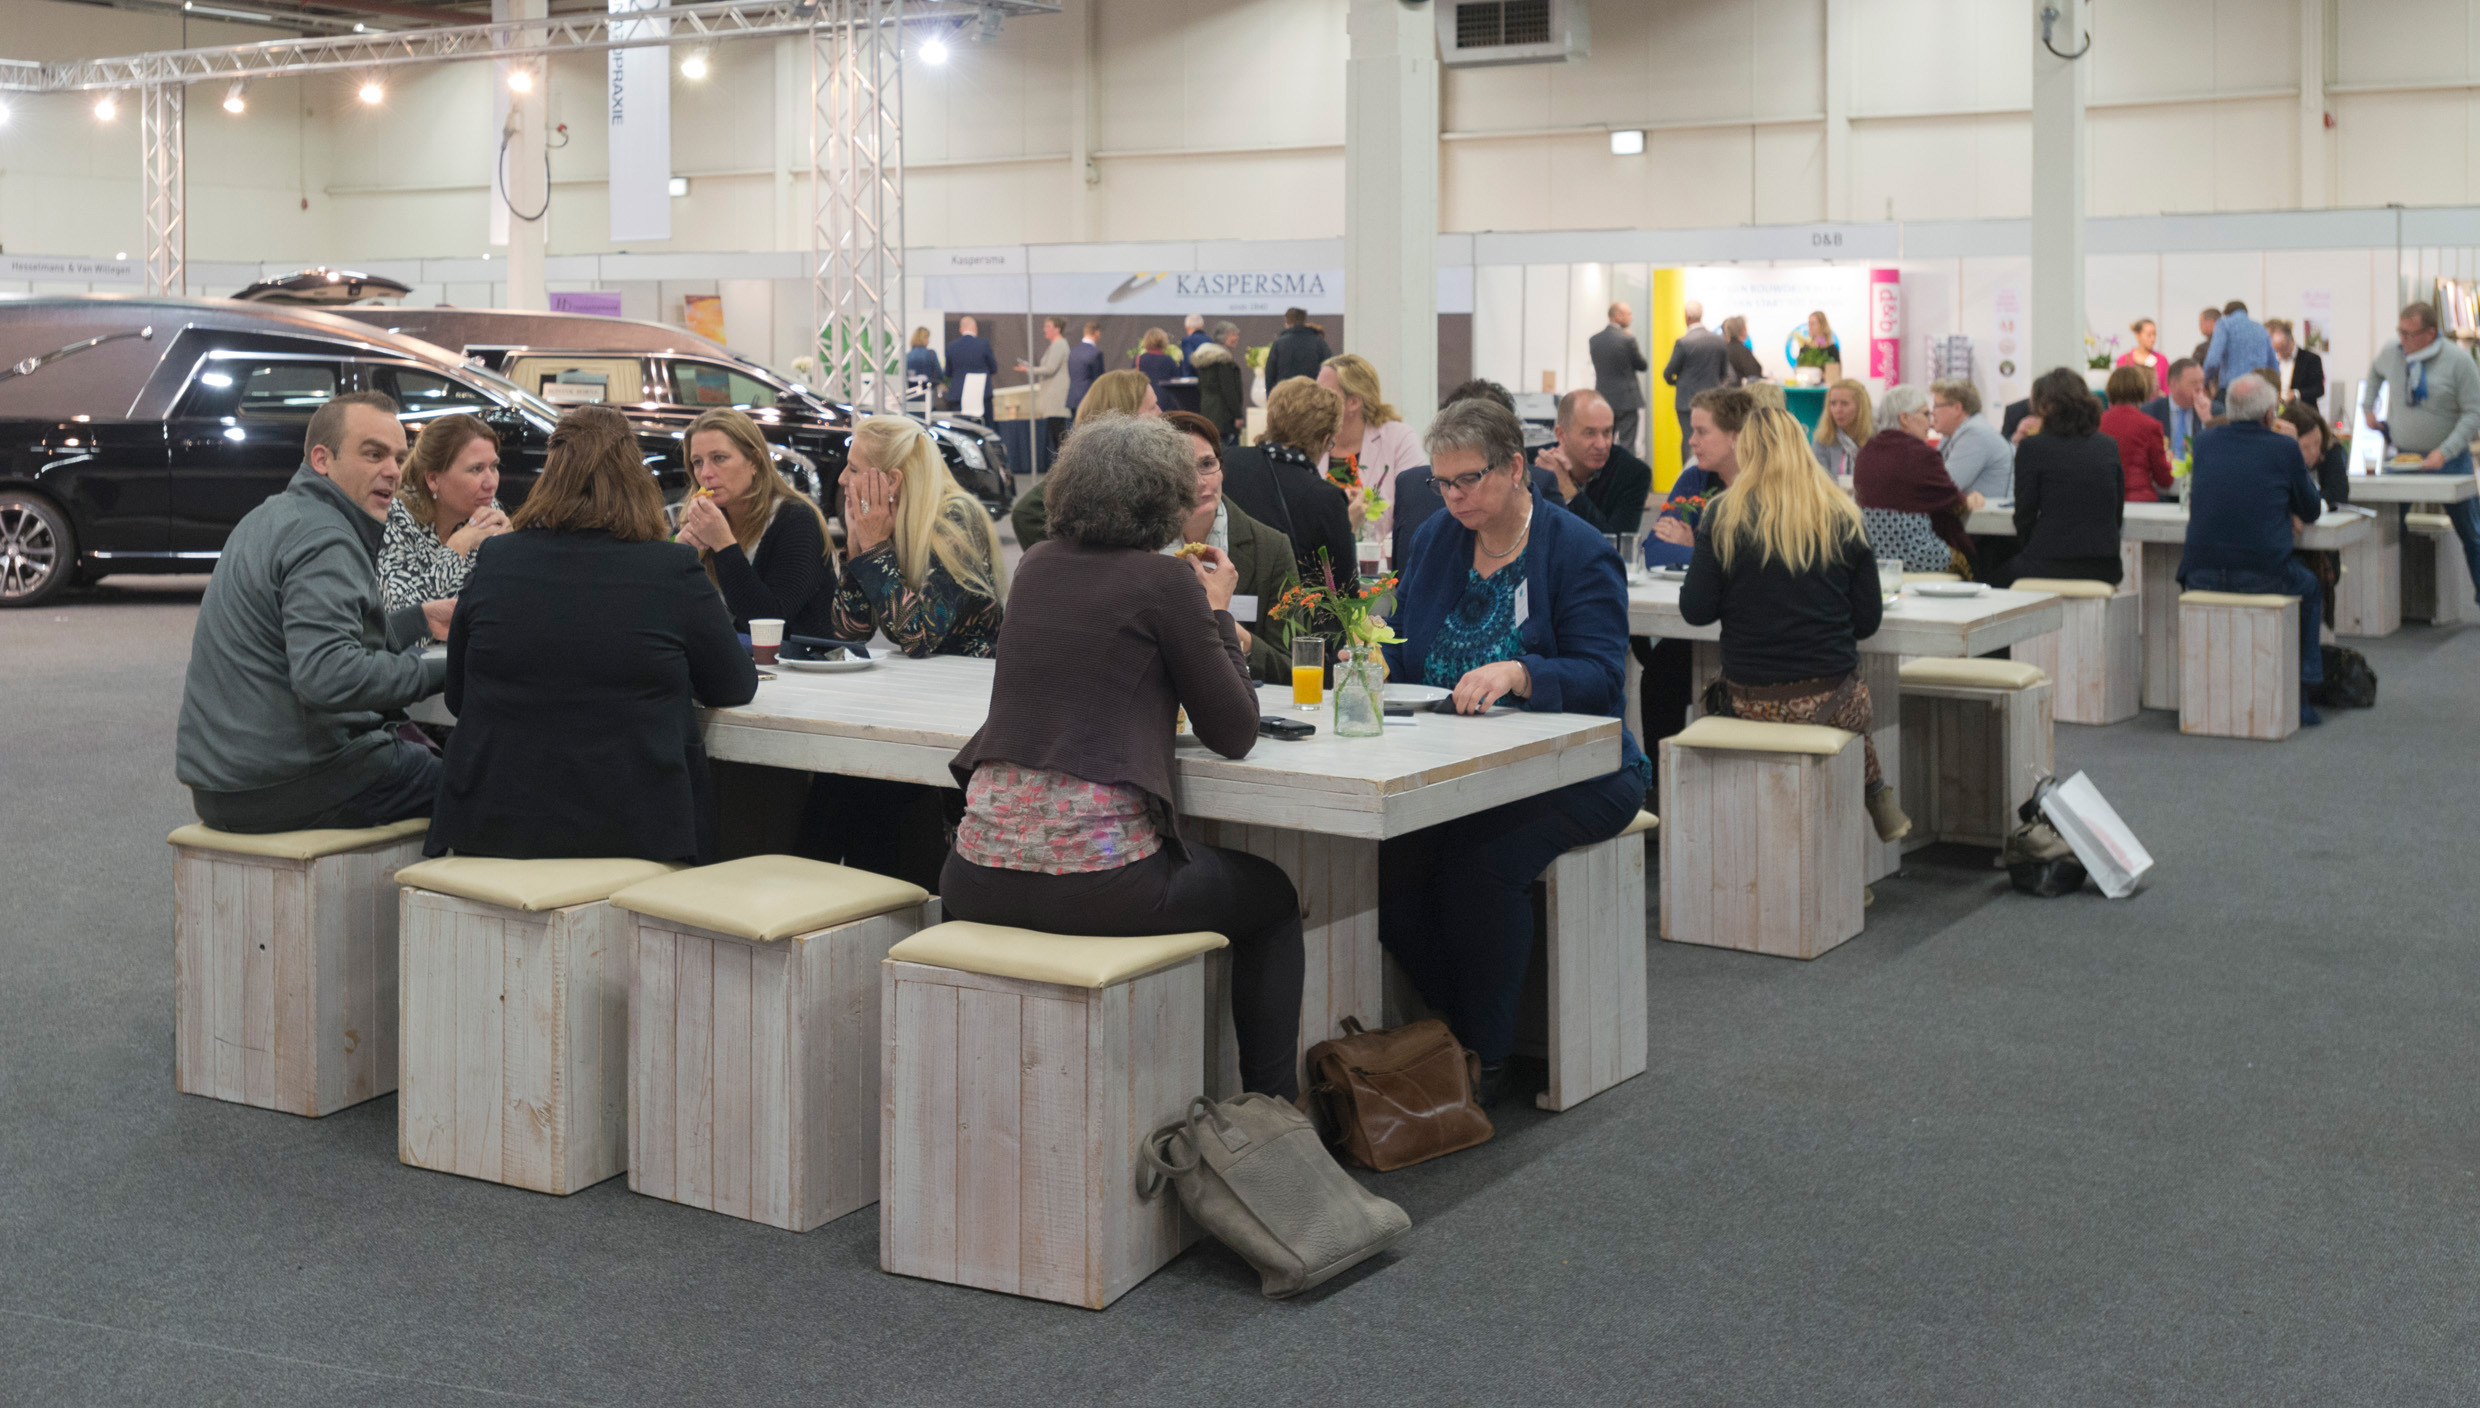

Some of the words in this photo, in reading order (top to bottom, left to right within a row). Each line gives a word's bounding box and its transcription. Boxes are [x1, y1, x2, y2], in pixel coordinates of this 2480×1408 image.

[1811, 232, 1843, 247] D&B
[11, 261, 65, 273] Hesselmans
[68, 262, 75, 273] &
[77, 263, 93, 273] Van
[950, 254, 1005, 267] Kaspersma
[1176, 273, 1325, 294] KASPERSMA
